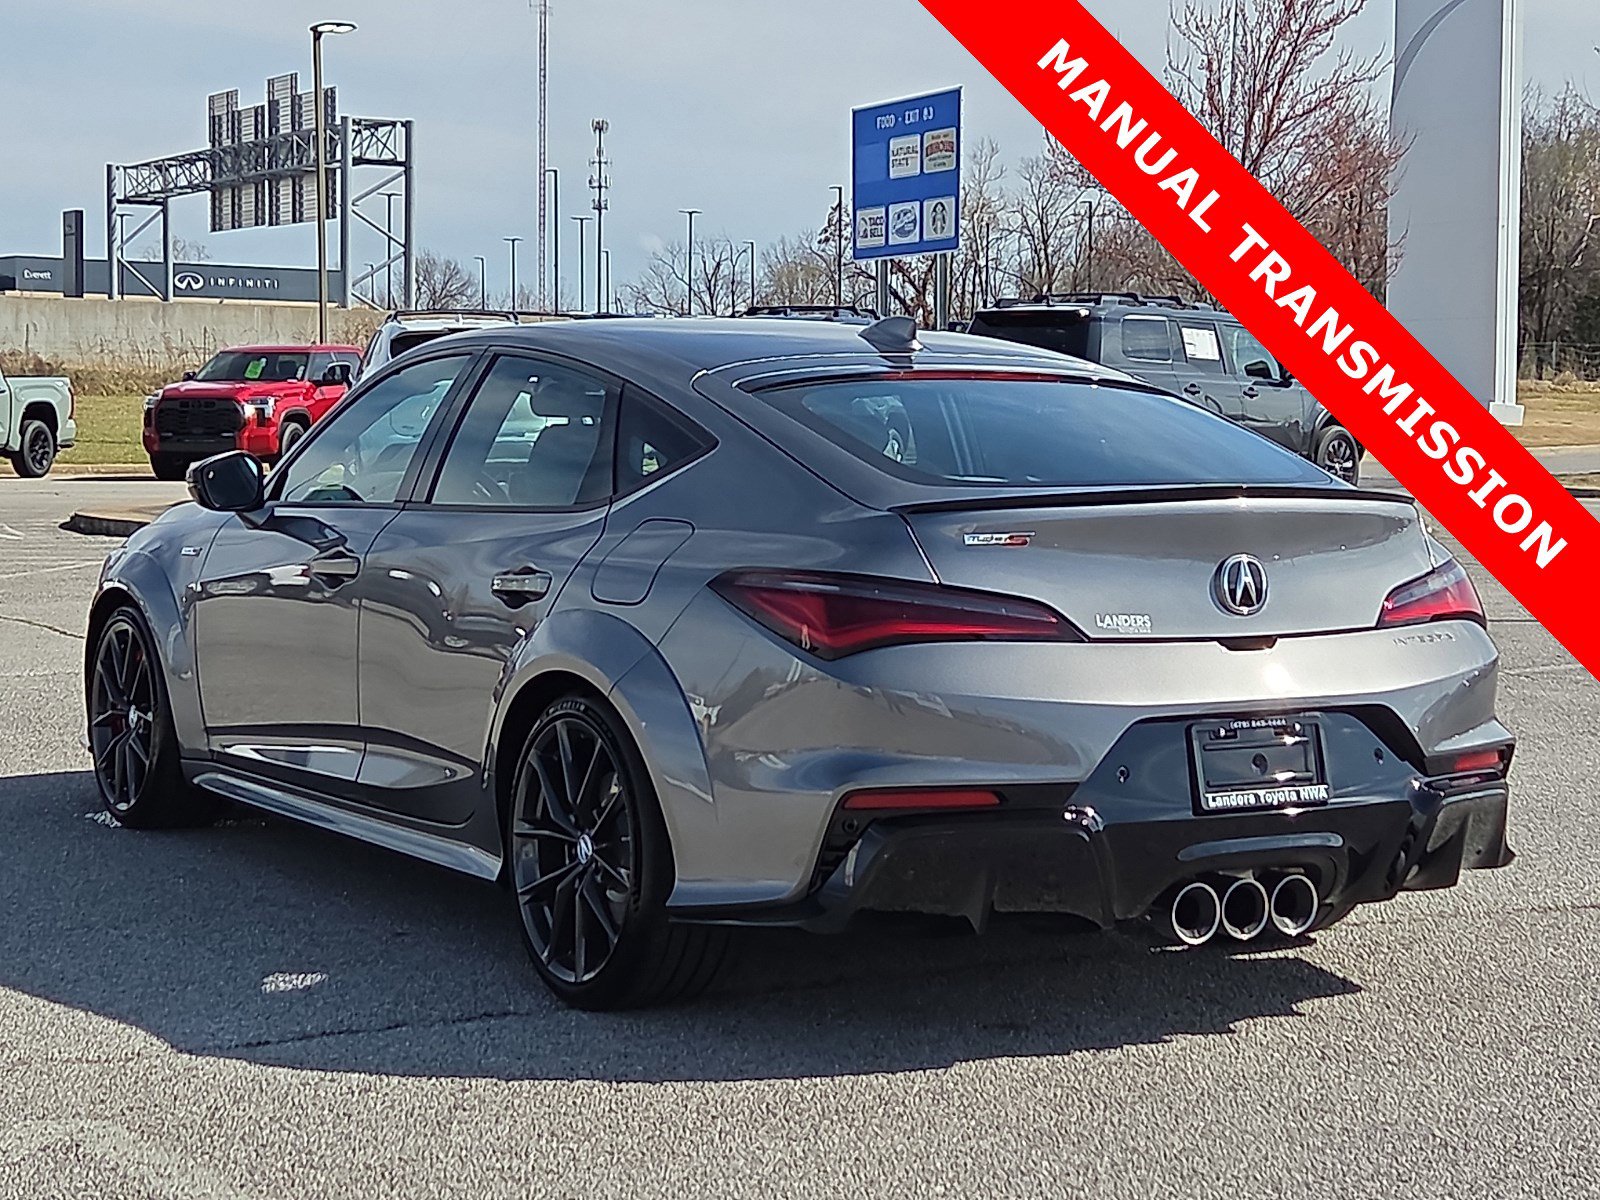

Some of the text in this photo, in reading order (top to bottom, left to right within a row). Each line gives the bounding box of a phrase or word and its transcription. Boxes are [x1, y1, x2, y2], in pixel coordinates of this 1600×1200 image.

[876, 114, 896, 130] FOOD
[904, 108, 920, 124] EXIT
[868, 216, 884, 227] TACO
[209, 276, 279, 290] INFINITI
[1095, 613, 1152, 629] LANDERS
[1206, 784, 1329, 809] Landers Toyota NWA
